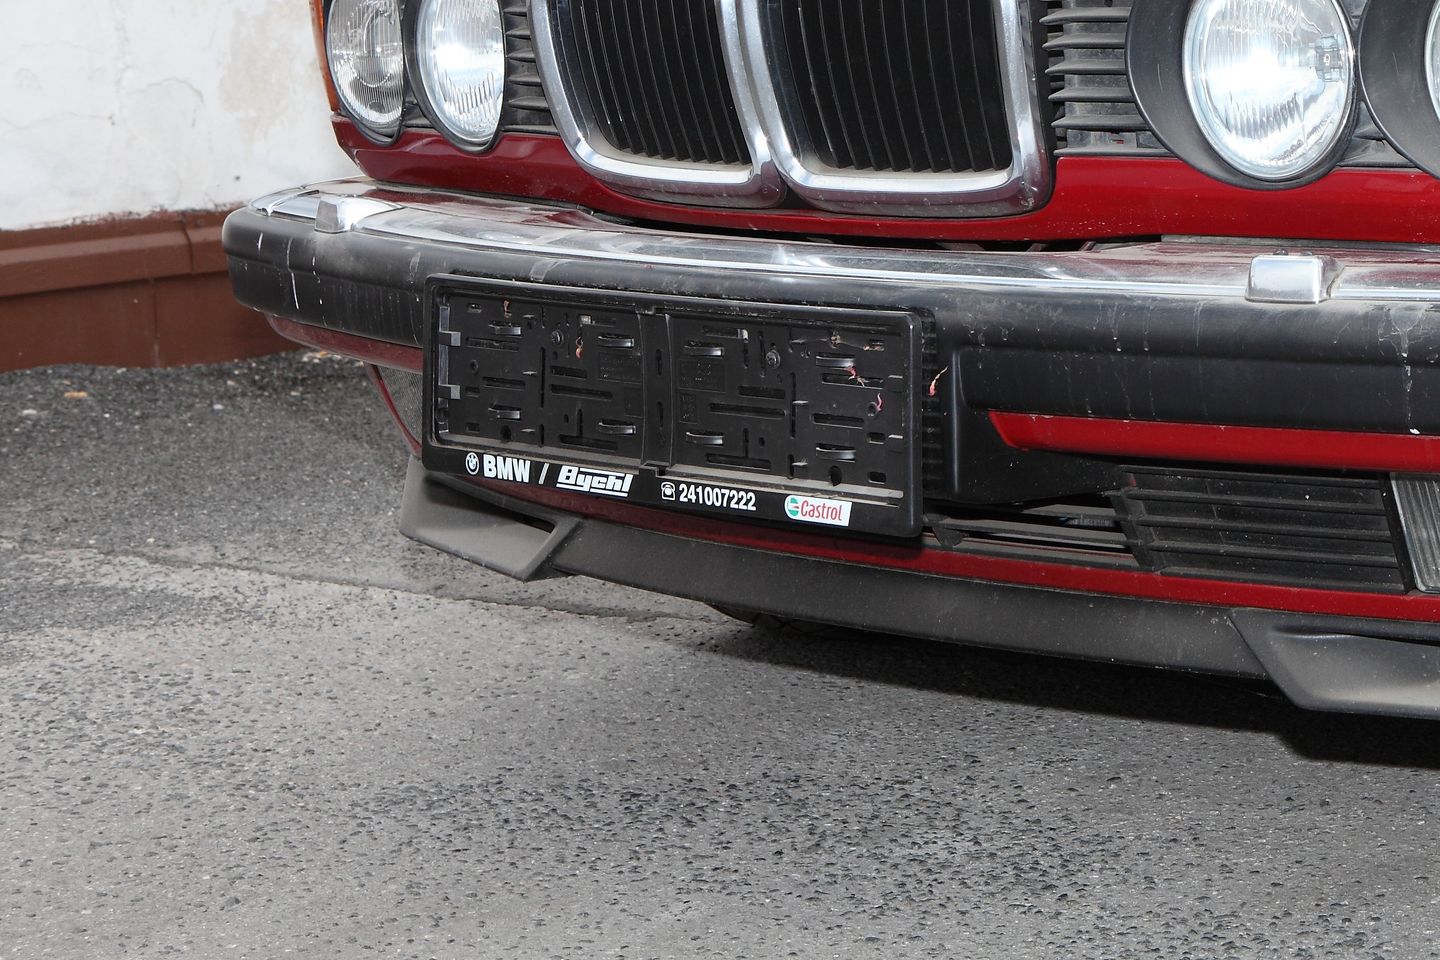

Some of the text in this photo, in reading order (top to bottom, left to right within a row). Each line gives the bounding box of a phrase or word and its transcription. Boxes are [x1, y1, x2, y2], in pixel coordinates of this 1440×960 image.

[483, 453, 531, 483] BMW
[556, 465, 634, 497] Bychl
[679, 483, 757, 511] 241007222
[800, 499, 844, 521] Castrol
